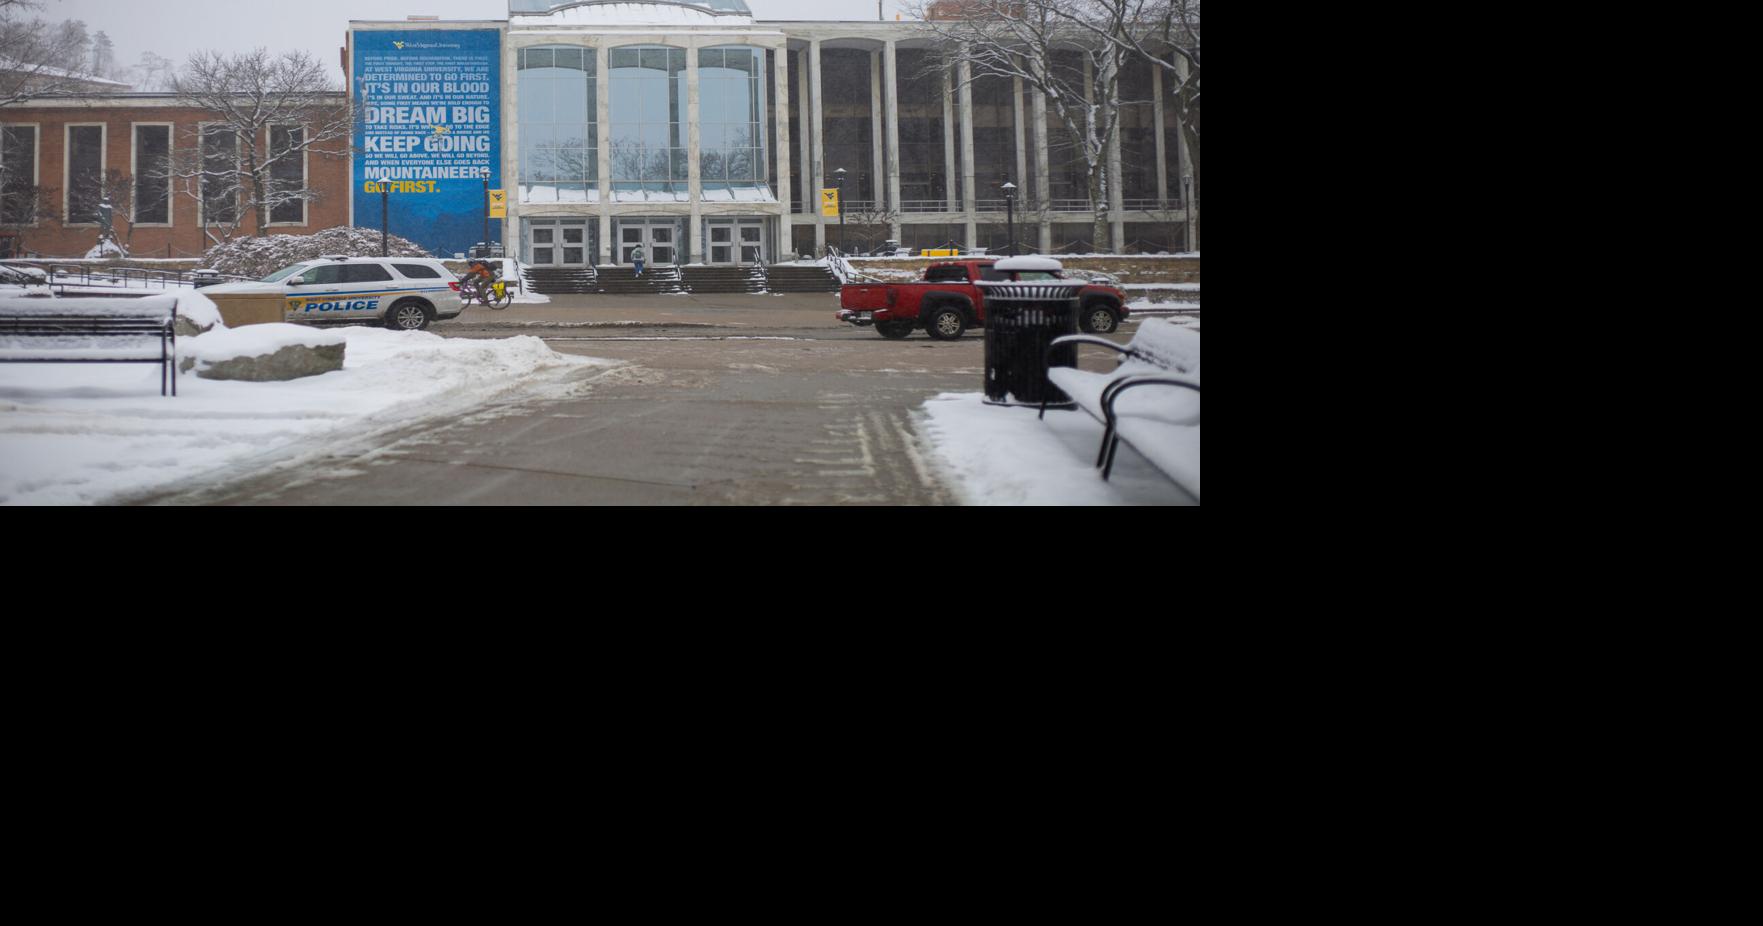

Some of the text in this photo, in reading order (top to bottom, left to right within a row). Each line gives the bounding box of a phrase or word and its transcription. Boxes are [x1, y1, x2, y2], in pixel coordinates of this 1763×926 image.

[365, 73, 489, 81] DETERMINED TO GO FIRST.
[366, 82, 489, 93] IT'S IN OUR BLOOD
[365, 106, 490, 123] DREAM BIG
[365, 136, 490, 152] KEEP GOING
[390, 181, 441, 193] FIRST.
[304, 301, 379, 312] POLICE
